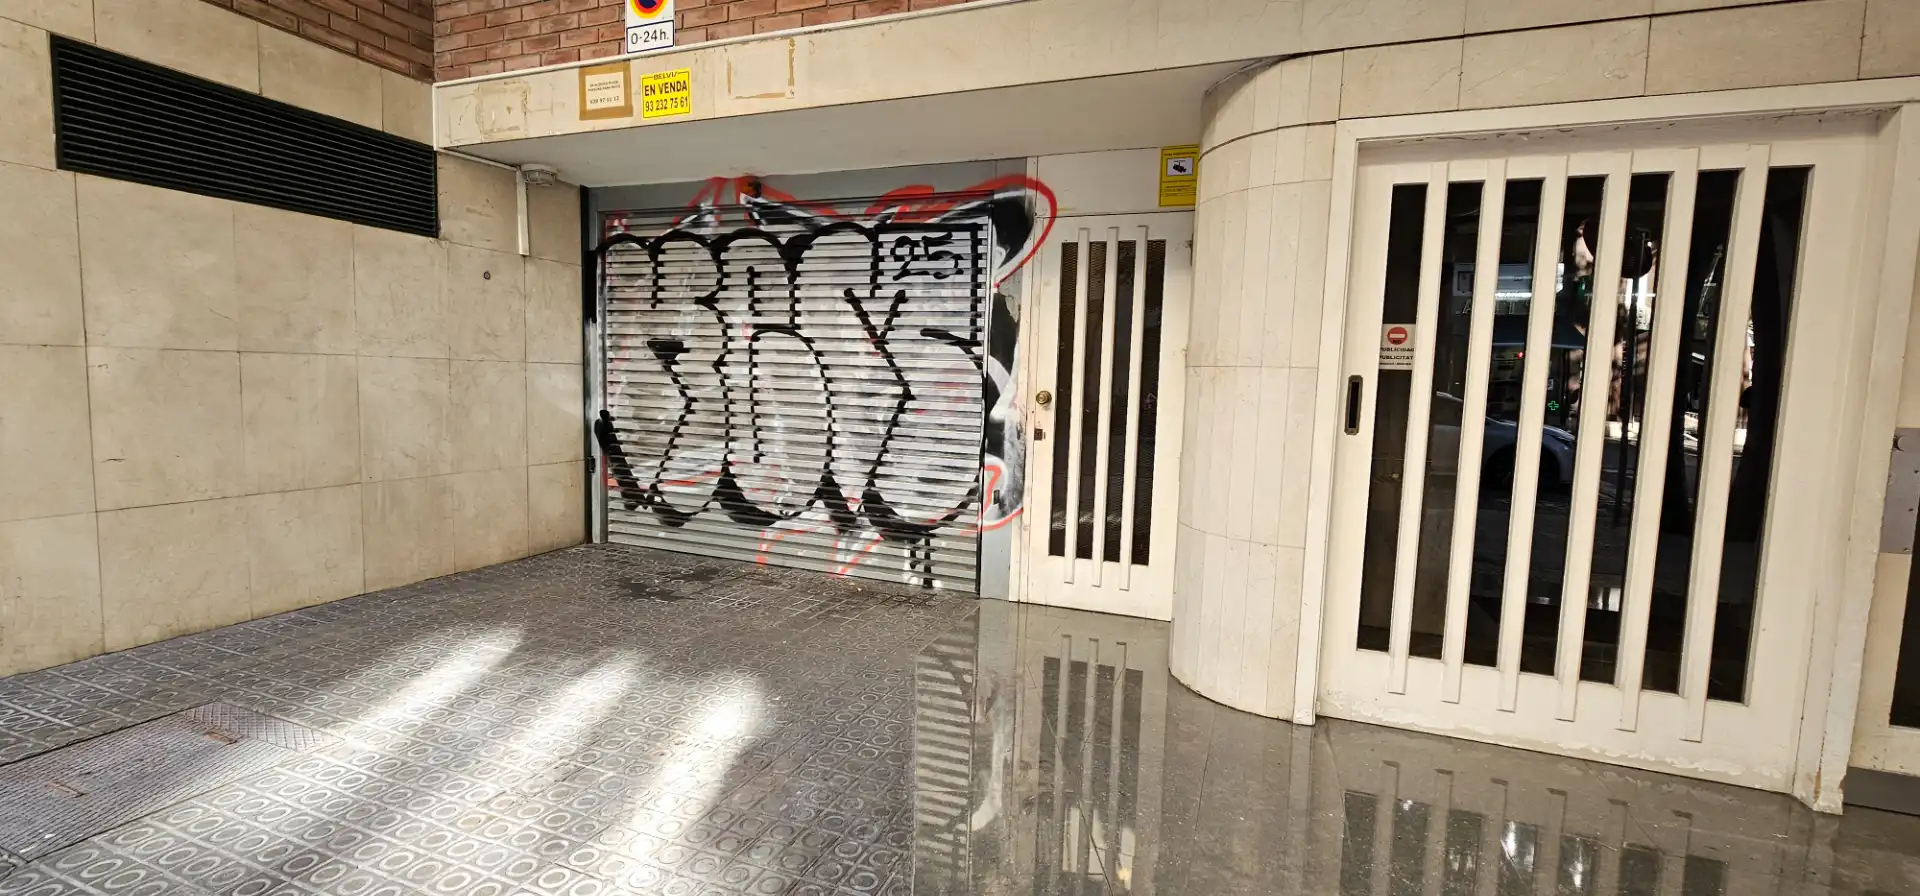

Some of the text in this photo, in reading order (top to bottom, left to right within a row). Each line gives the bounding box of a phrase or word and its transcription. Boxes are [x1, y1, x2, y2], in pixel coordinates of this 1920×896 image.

[644, 80, 688, 97] EN VENDA
[645, 96, 689, 112] 93 232 75 61
[893, 231, 964, 281] 25
